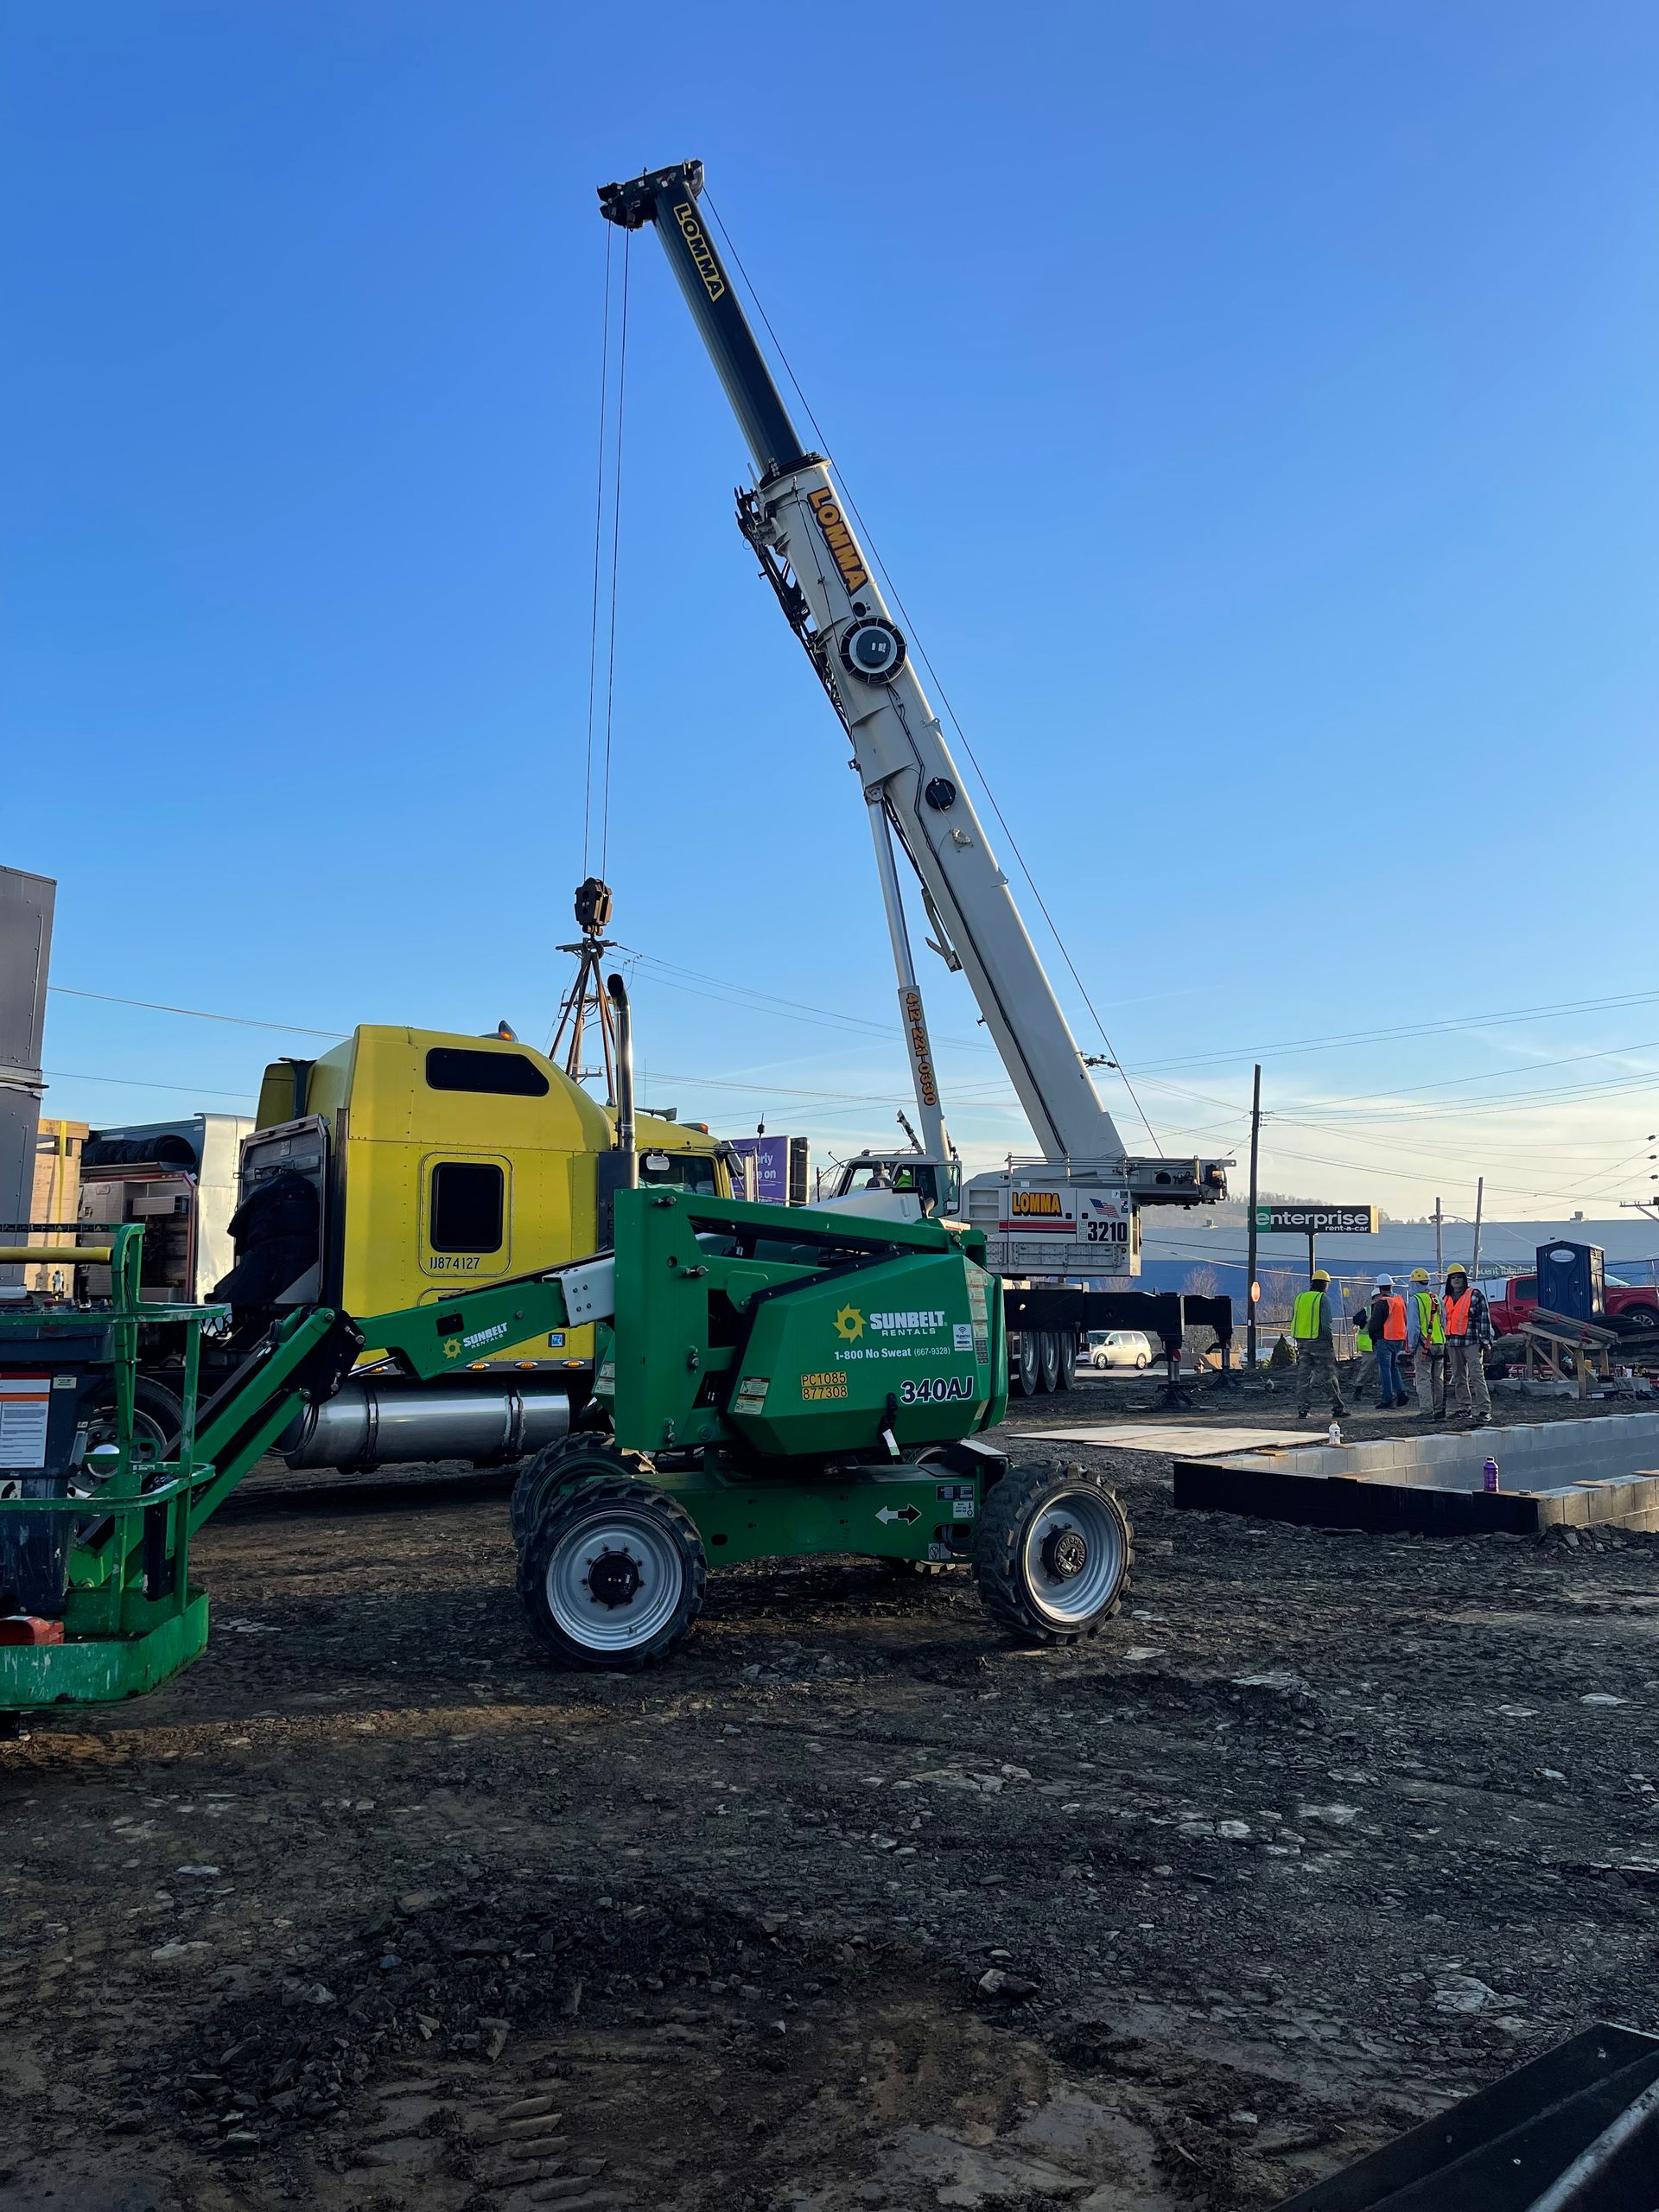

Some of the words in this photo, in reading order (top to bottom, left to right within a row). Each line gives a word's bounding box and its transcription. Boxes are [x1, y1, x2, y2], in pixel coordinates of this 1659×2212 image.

[674, 202, 725, 302] LOMMA
[808, 486, 868, 597] LOMMA
[906, 993, 937, 1106] 412-221-0330
[1012, 1192, 1063, 1217] LOMMA
[1255, 1211, 1370, 1229] enterprise
[1087, 1221, 1128, 1242] 3210
[869, 1310, 945, 1330] SUNBELT
[462, 1322, 508, 1348] SUNBELT
[471, 1334, 504, 1349] RENTALS
[881, 1327, 937, 1337] RENTALS
[834, 1350, 863, 1361] 1-800
[865, 1348, 880, 1359] No
[881, 1347, 912, 1358] Sweat
[913, 1345, 950, 1357] (667-9328)
[802, 1372, 846, 1386] PC1085
[803, 1386, 848, 1400] 877308
[899, 1376, 974, 1405] 340AJ
